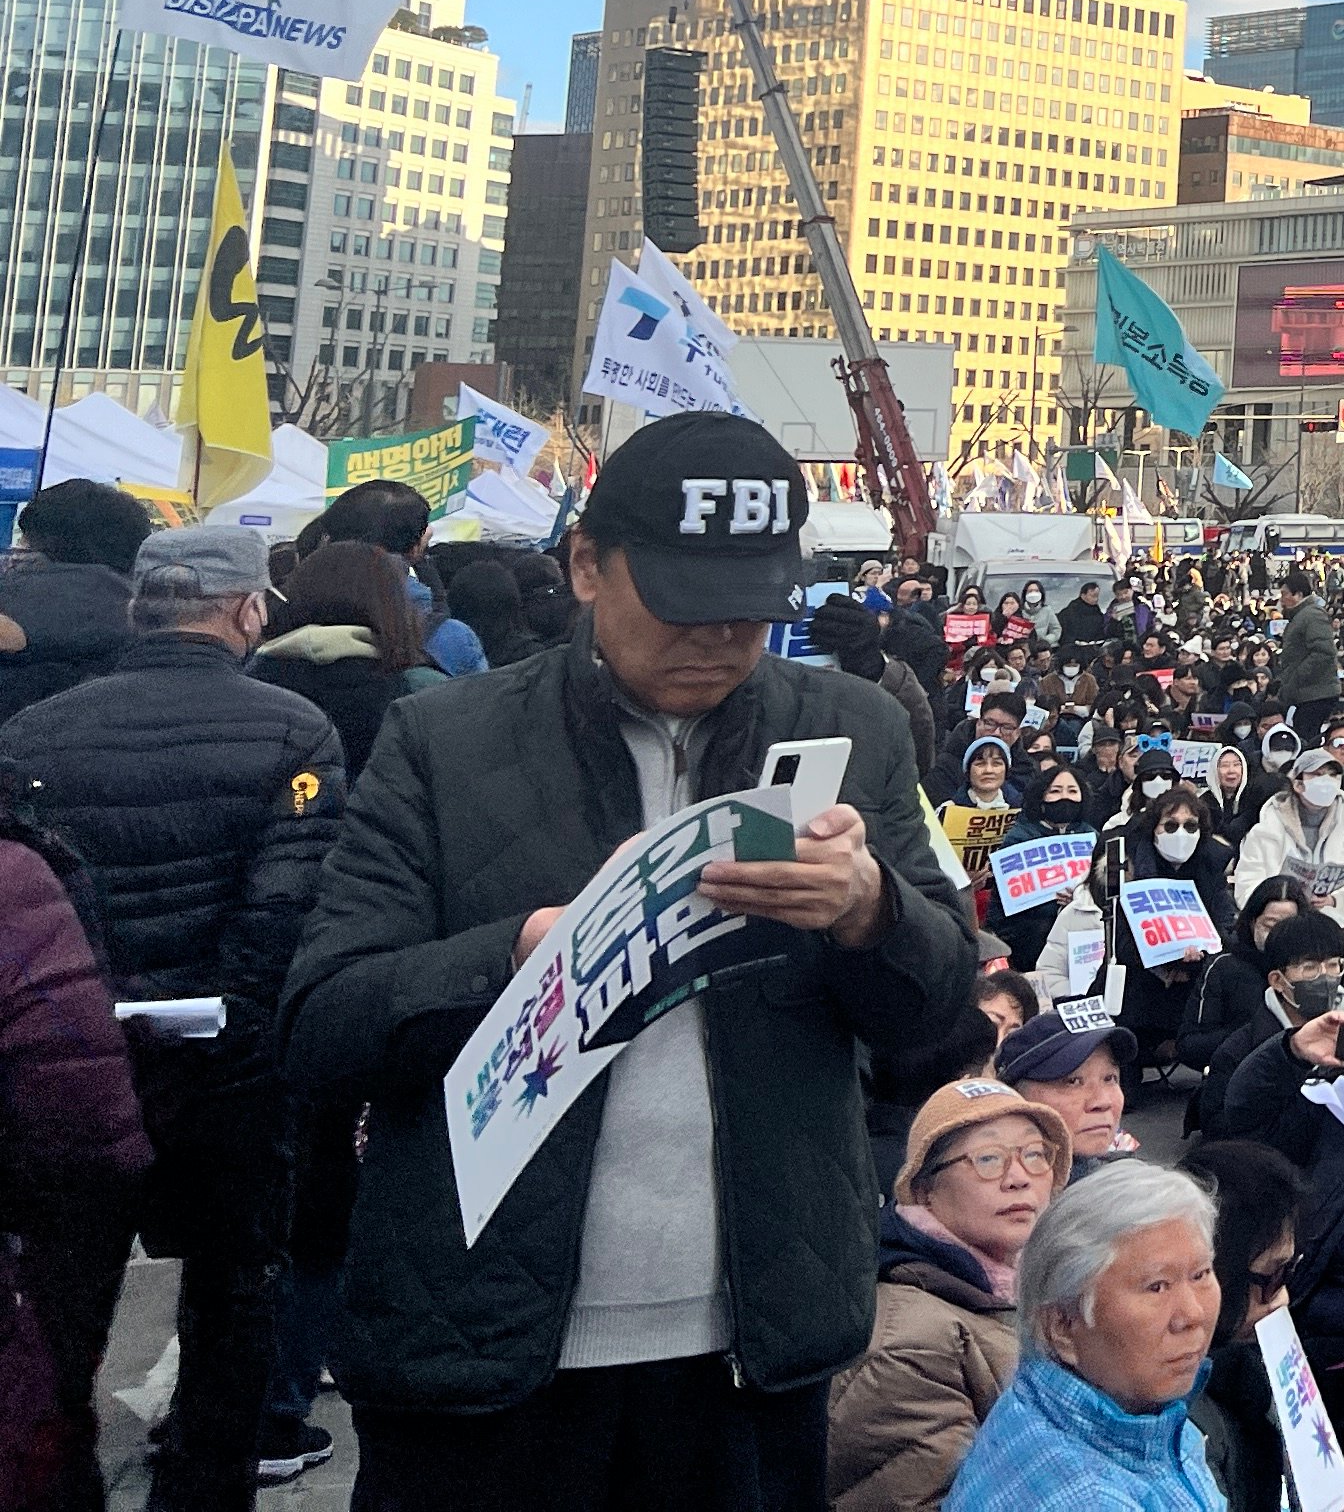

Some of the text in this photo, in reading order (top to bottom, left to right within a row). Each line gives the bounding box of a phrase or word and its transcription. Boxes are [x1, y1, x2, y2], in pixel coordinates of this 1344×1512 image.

[680, 478, 790, 535] FBI
[1000, 839, 1094, 875] 국민의힘
[1126, 888, 1202, 914] 국민의힘
